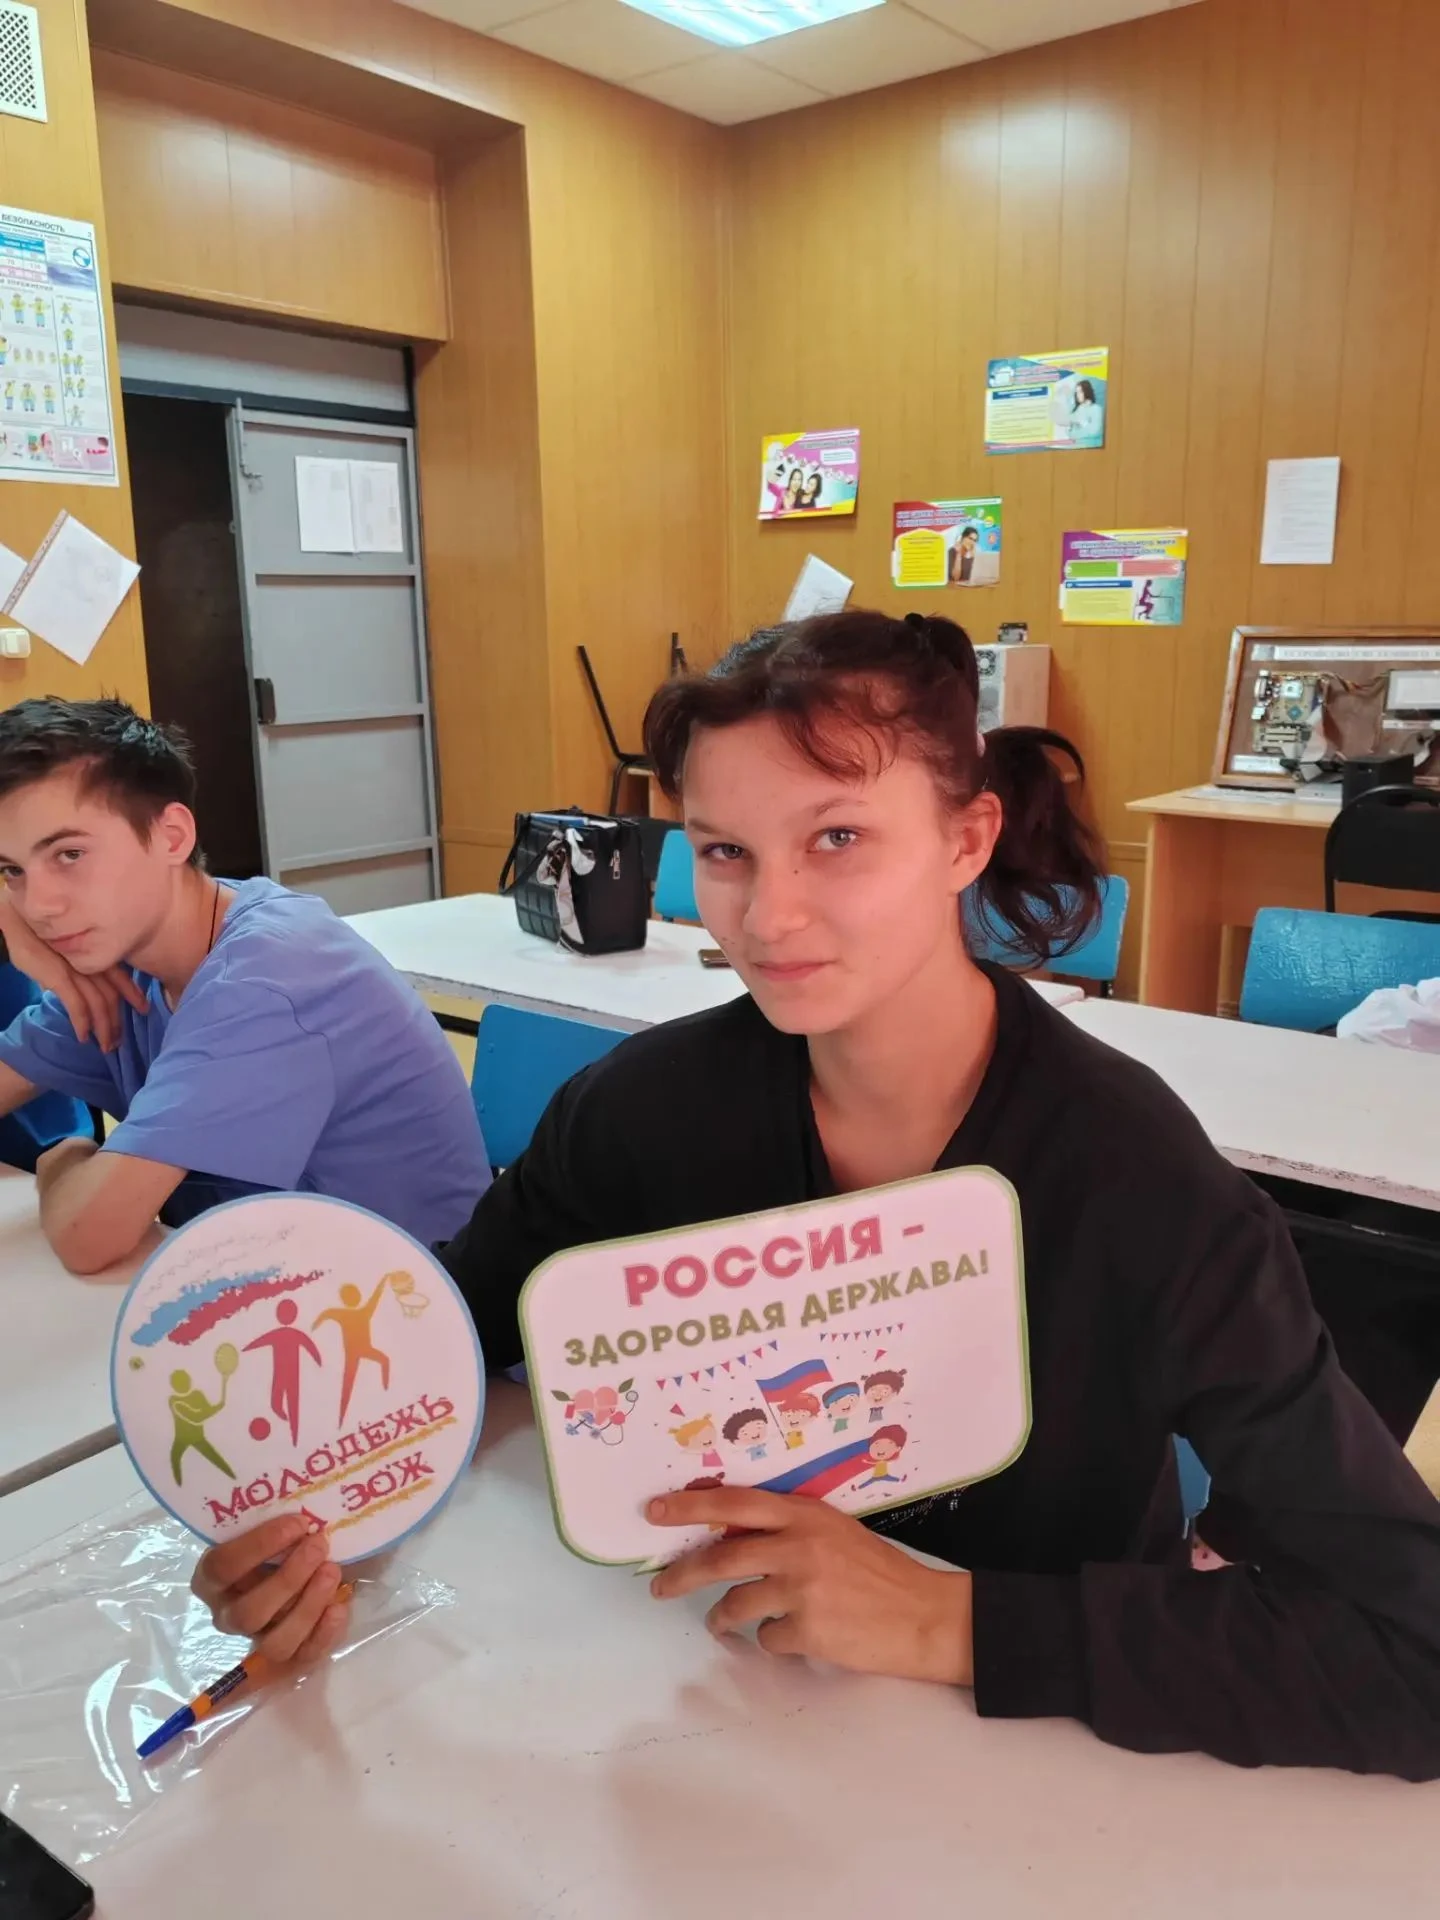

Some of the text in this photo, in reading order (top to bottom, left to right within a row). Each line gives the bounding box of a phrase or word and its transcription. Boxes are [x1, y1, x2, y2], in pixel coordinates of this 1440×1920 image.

[1, 213, 66, 233] БЕЗОПАСНОСТЬ
[623, 1214, 925, 1308] РОССИЯ -
[563, 1249, 990, 1368] ЗДОРОВАЯ ДЕРЖАВА!
[206, 1394, 455, 1524] МОЛОДЕЖЬ
[340, 1451, 435, 1512] ЗОЖ
